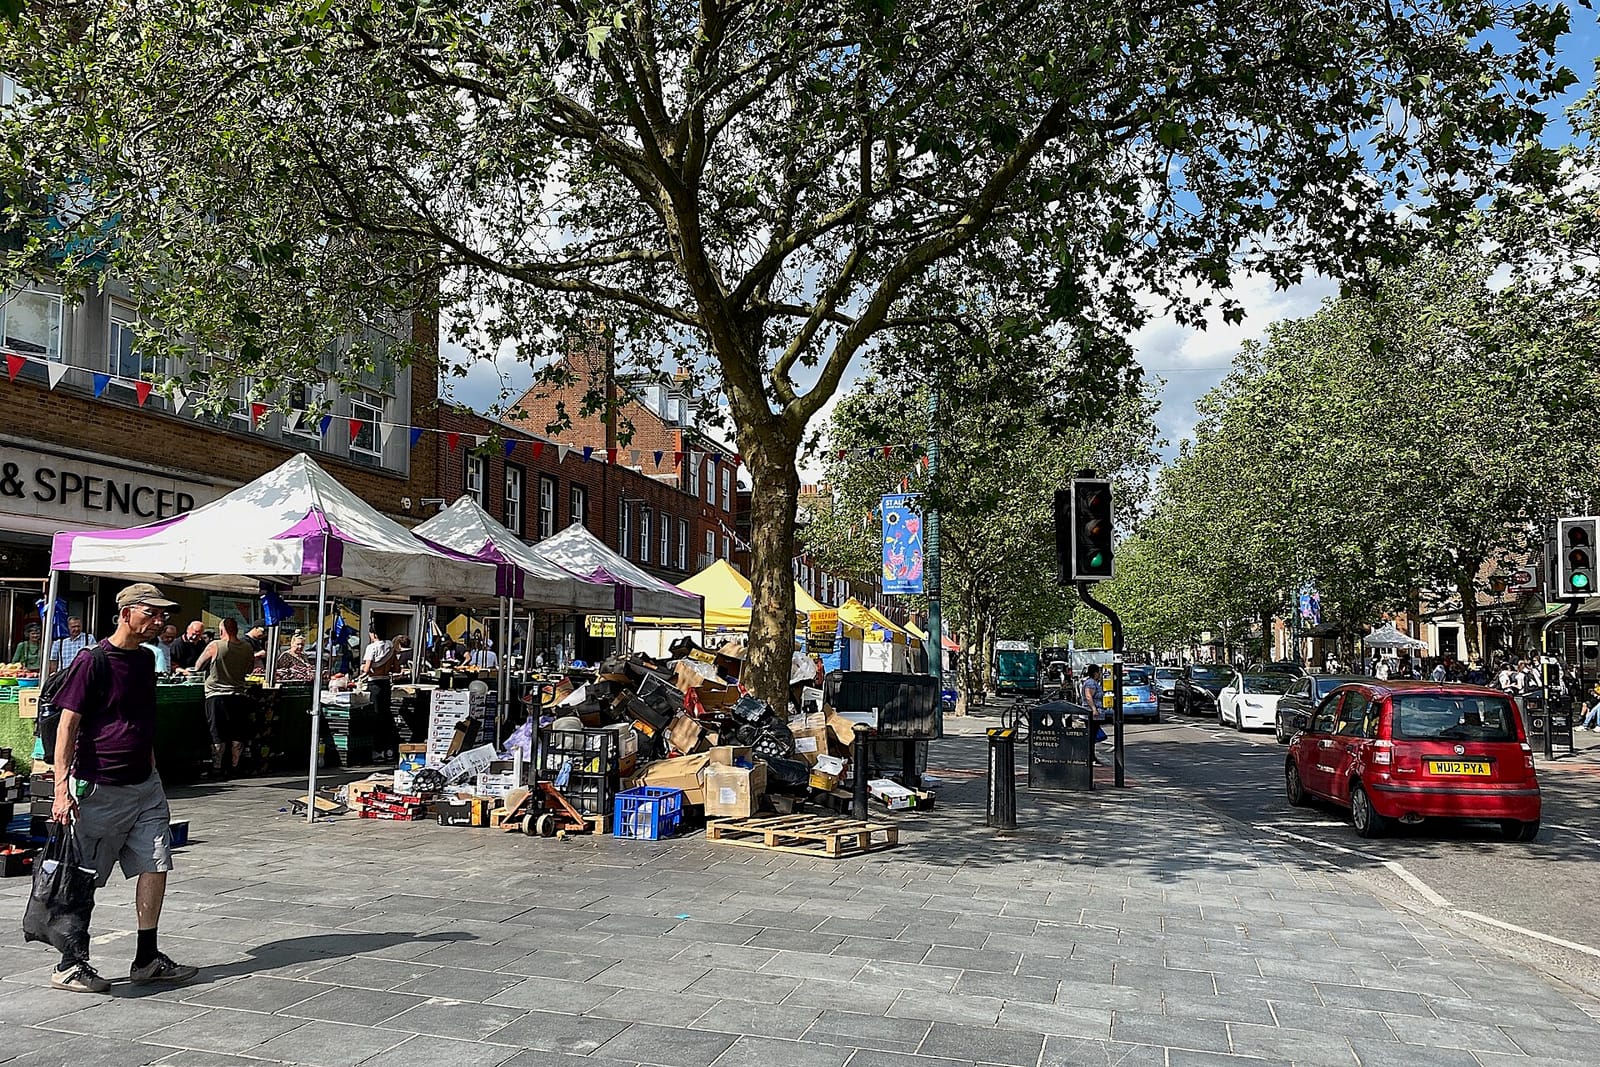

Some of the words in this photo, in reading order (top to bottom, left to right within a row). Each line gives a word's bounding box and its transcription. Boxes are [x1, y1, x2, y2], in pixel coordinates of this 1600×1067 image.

[1, 463, 26, 499] &
[1436, 763, 1461, 773] WU12
[1464, 763, 1485, 773] PYA
